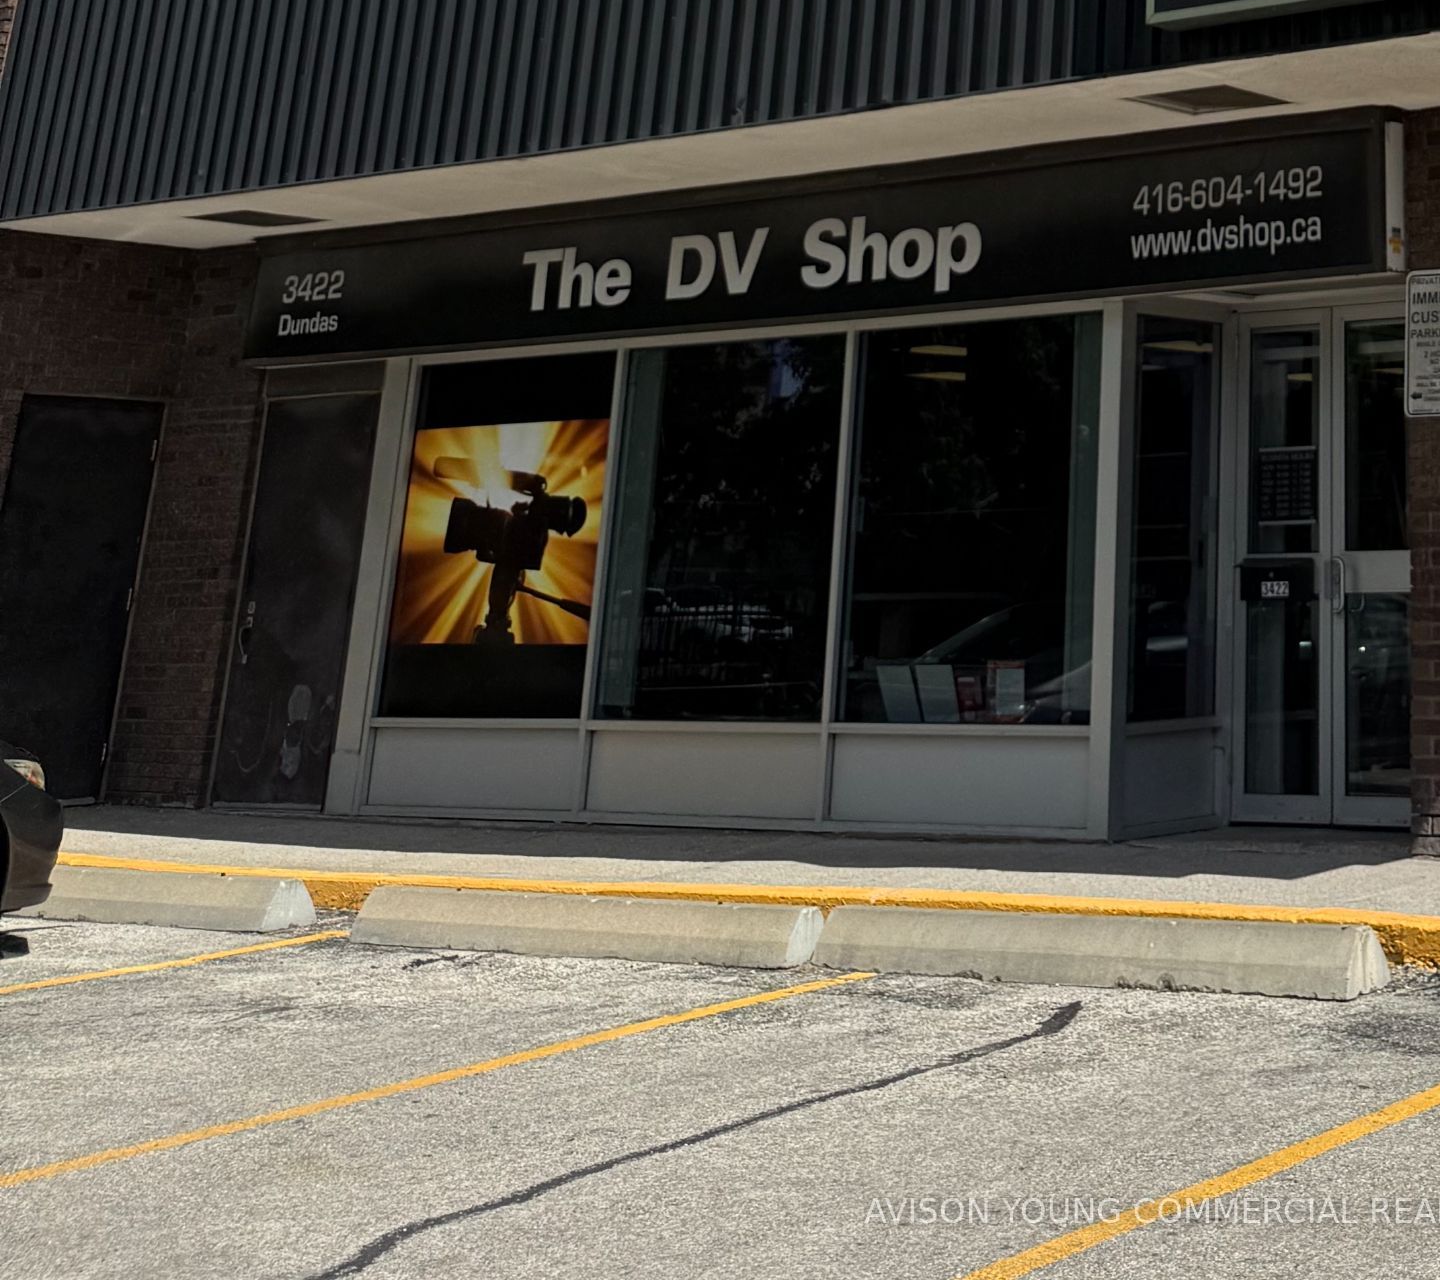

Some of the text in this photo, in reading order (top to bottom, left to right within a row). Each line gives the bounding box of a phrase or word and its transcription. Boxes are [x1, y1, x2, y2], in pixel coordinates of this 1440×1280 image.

[1132, 165, 1323, 216] 416-604-1492
[1131, 214, 1322, 260] www.dvshop.ca
[522, 216, 982, 312] The DV Shop
[282, 270, 344, 304] 3422
[277, 312, 339, 337] Dundas
[1262, 581, 1289, 596] 3422
